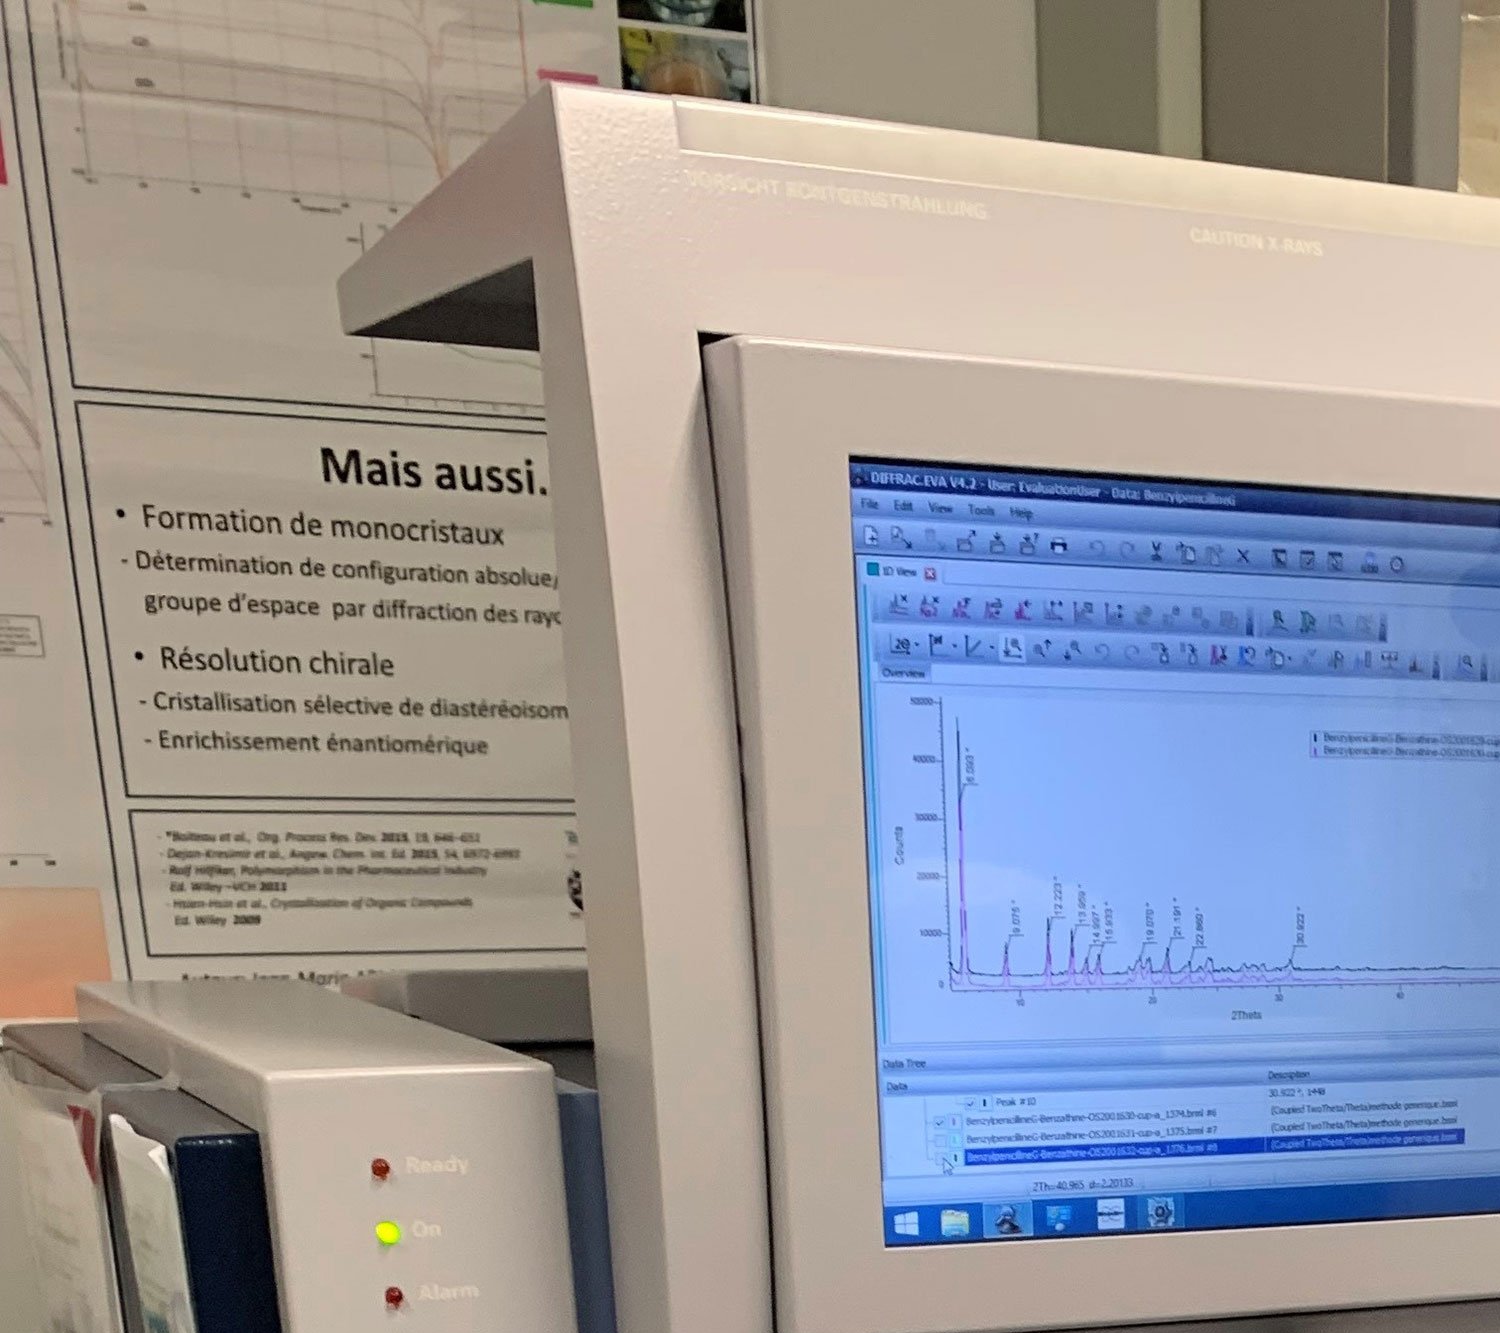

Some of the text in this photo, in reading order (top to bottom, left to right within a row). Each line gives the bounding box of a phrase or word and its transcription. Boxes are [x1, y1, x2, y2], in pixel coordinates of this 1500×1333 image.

[1189, 226, 1324, 257] CAUTION X-RAYS
[320, 446, 549, 496] Mais aussi.
[862, 498, 1034, 520] File Edit View Tools Help
[141, 504, 505, 548] Formation de monocristaux
[135, 550, 293, 577] Détermination
[299, 559, 326, 579] de
[331, 562, 469, 586] configuration
[144, 592, 222, 616] groupe
[332, 600, 366, 621] par
[371, 599, 477, 624] diffraction
[483, 604, 518, 625] des
[159, 646, 395, 678] Résolution chirale
[152, 691, 570, 721] Cristallisation sélective de diastéréoisom
[158, 730, 489, 757] Enrichissement énantiomérique
[406, 1155, 470, 1175] Ready
[412, 1221, 442, 1239] On
[418, 1284, 481, 1301] Alarm
